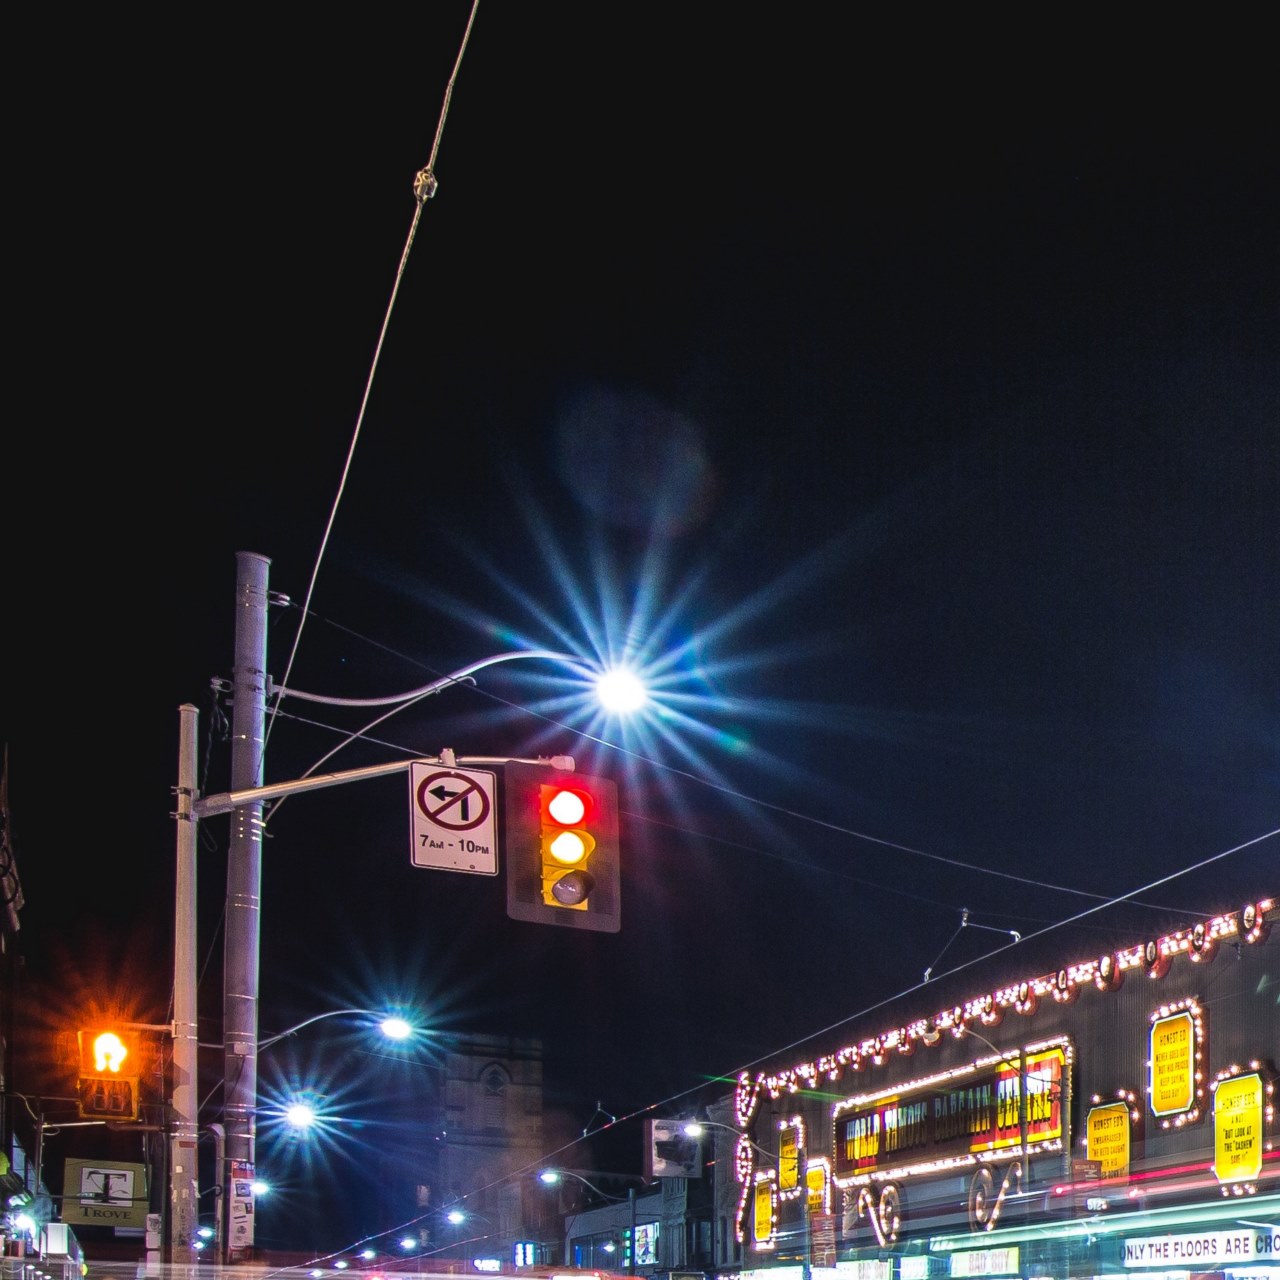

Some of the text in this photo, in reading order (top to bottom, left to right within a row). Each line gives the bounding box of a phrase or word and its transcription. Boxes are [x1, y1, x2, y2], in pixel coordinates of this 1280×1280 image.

[420, 834, 445, 850] 7AM
[459, 839, 489, 854] 10PM
[1159, 1031, 1179, 1047] HONEST
[1093, 1117, 1112, 1131] HONEST
[1234, 1126, 1246, 1138] LOOK
[1246, 1125, 1252, 1136] AT
[1224, 1141, 1233, 1153] THE
[80, 1206, 132, 1220] TROVE
[1120, 1243, 1145, 1261] ONLY
[1148, 1242, 1169, 1260] THE
[1173, 1238, 1217, 1258] FLOORS
[1224, 1236, 1250, 1255] ARE
[968, 1250, 1010, 1273] BAD BOY
